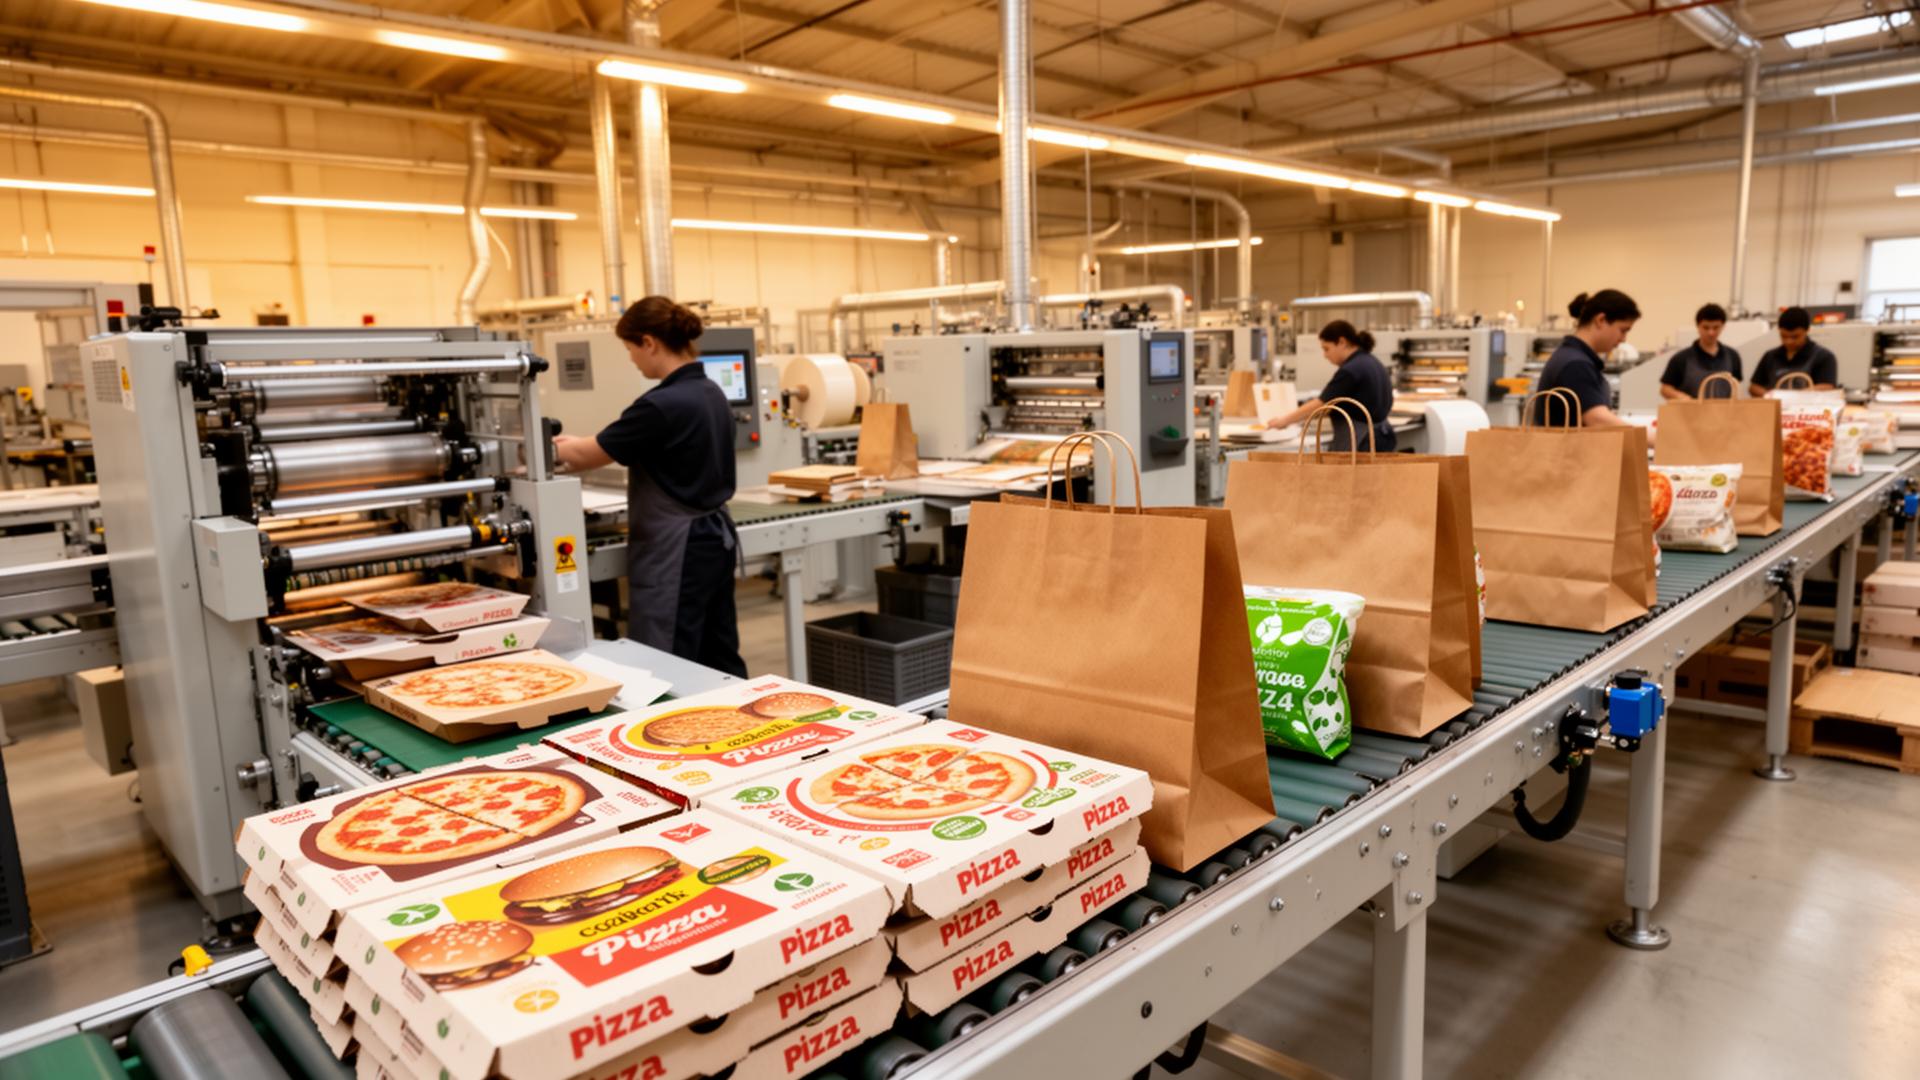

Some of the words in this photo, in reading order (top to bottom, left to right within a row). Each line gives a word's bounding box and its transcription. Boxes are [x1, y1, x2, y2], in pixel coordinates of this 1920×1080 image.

[1082, 795, 1131, 832] Pizza
[956, 848, 1021, 895] Pizza
[1067, 837, 1115, 880] Pizza
[1080, 873, 1127, 914] Pizza
[779, 913, 854, 965] Pizza
[939, 898, 1003, 948] Pizza
[952, 940, 1014, 991] Pizza
[777, 965, 851, 1020] Pizza
[569, 994, 674, 1062] Pizza
[783, 1014, 861, 1074] Pizza
